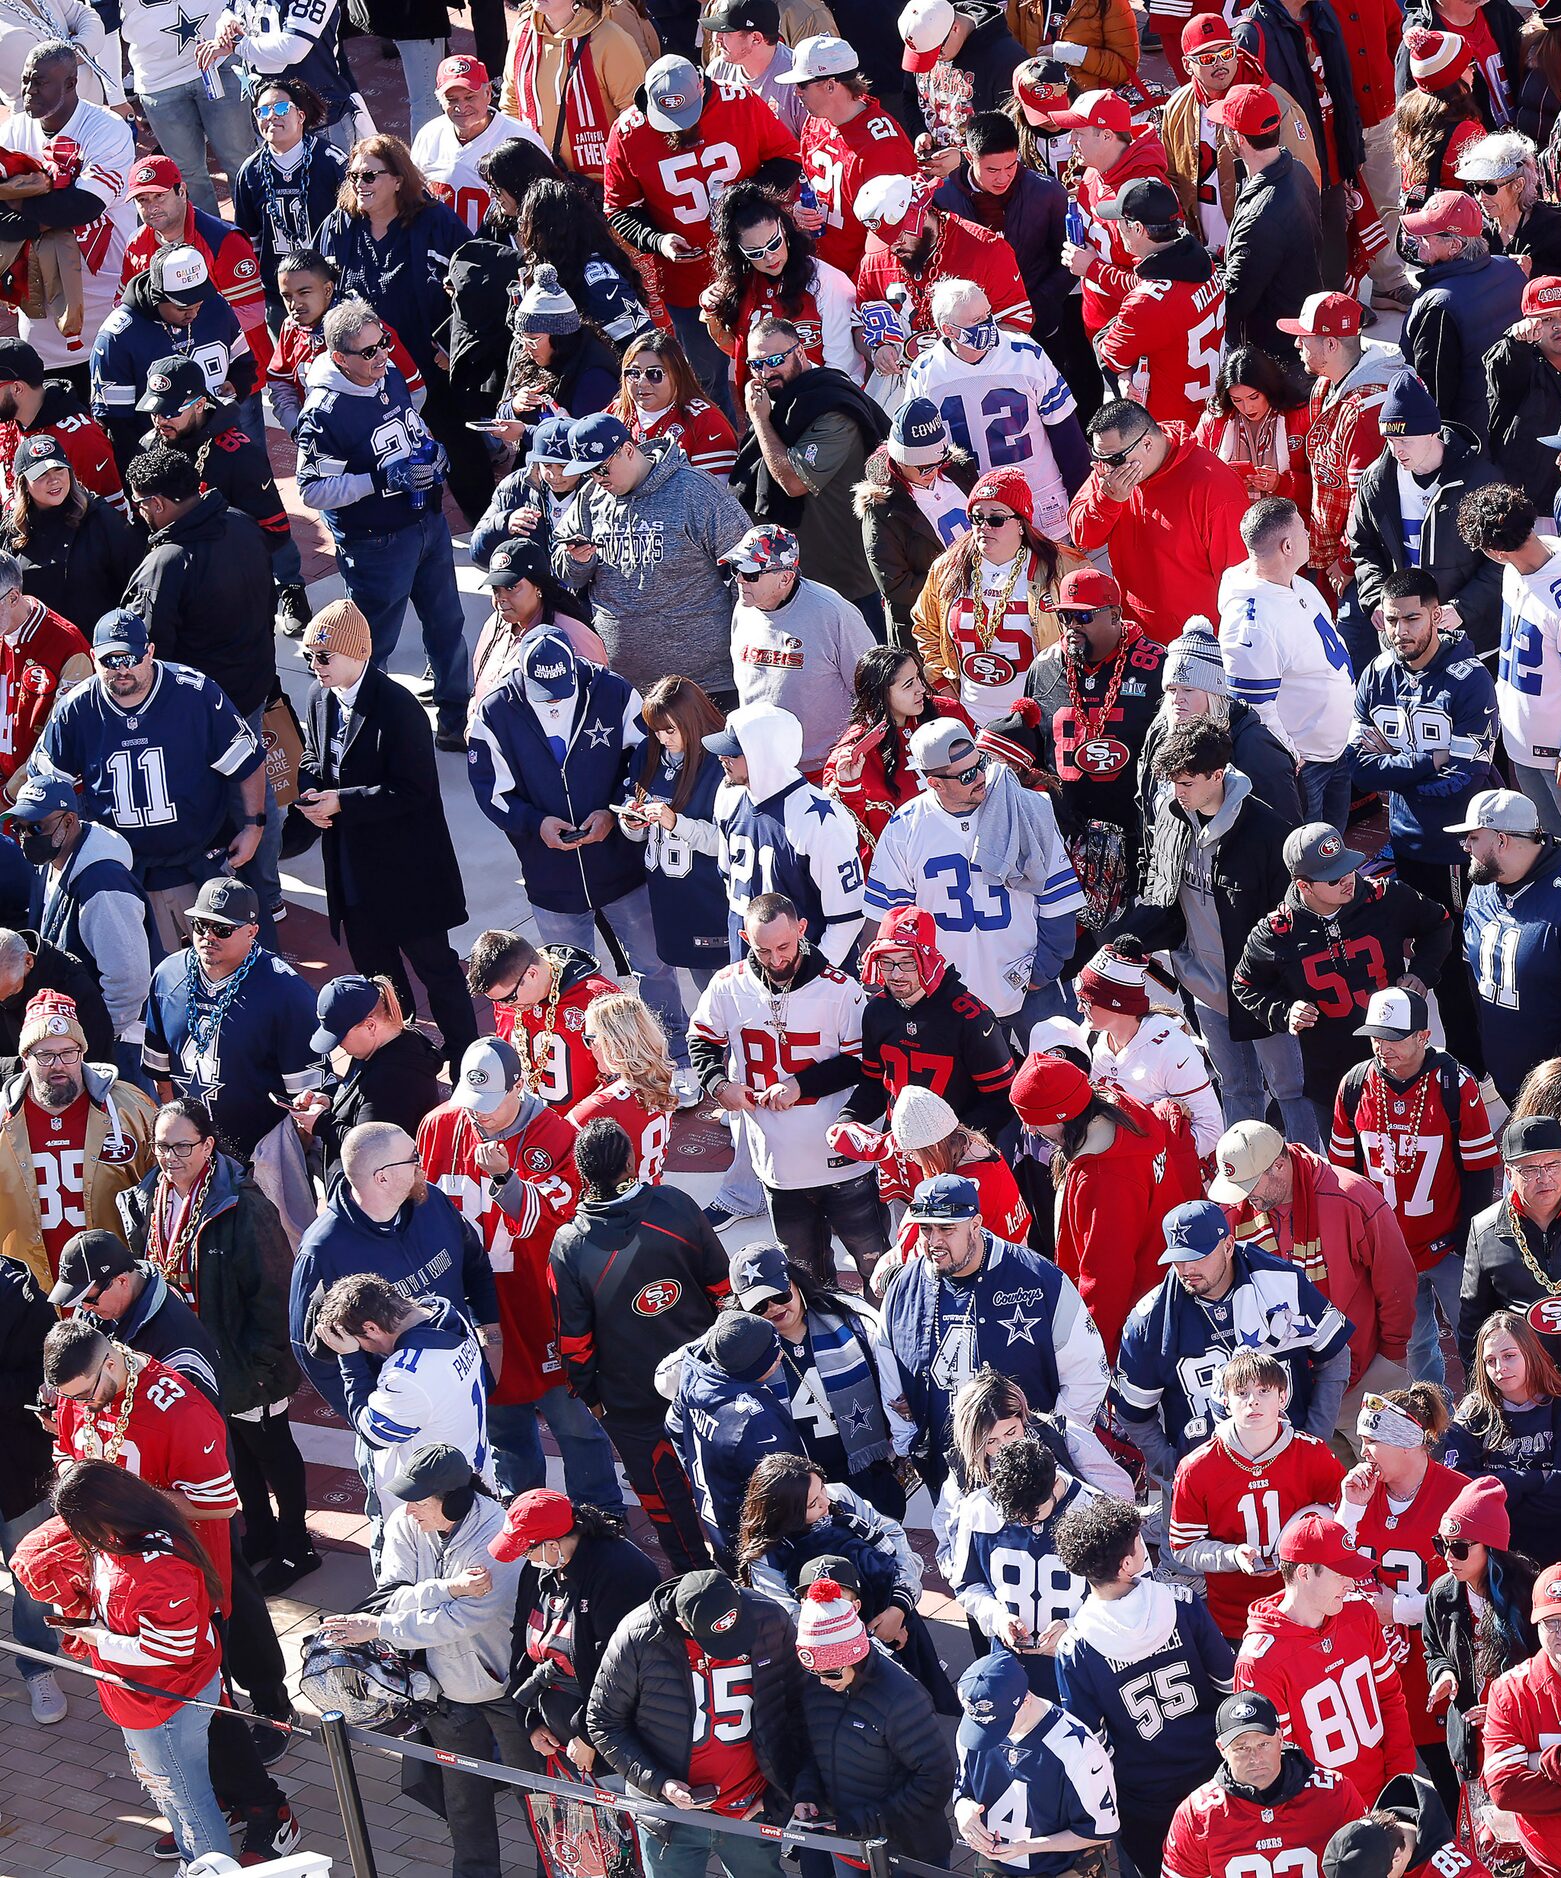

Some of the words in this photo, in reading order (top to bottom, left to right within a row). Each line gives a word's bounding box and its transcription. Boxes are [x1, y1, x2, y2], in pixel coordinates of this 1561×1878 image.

[867, 116, 899, 140] 21
[659, 142, 741, 224] 52
[175, 267, 202, 278] GALLERY
[181, 274, 200, 284] DEPT
[1192, 271, 1225, 312] WILLIS
[215, 426, 250, 452] 85
[938, 387, 1033, 470] 12
[535, 660, 564, 674] DALLAS
[1130, 637, 1166, 670] 85
[1312, 613, 1355, 686] 4
[534, 666, 567, 680] COWBOYS
[105, 747, 178, 829] 11
[839, 859, 863, 894] 21
[923, 853, 1013, 933] 33
[1301, 935, 1390, 1018] 53
[1477, 921, 1521, 1011] 11
[741, 1028, 821, 1105] 85
[1360, 1131, 1443, 1216] 97
[992, 1287, 1044, 1307] Cowboys
[392, 1348, 423, 1374] 11
[929, 1323, 977, 1417] 4
[146, 1377, 186, 1412] 23
[734, 1392, 763, 1416] 4
[792, 1366, 840, 1439] 4
[1248, 1479, 1270, 1489] 49ERS
[1238, 1491, 1284, 1552] 11
[1118, 1661, 1198, 1741] 55
[1300, 1655, 1385, 1768] 80
[457, 1758, 479, 1769] STADIUM
[1100, 1786, 1116, 1818] 4
[782, 1831, 806, 1842] STADIUM
[986, 1779, 1034, 1870] 4
[1255, 1837, 1283, 1850] 49ERS
[1431, 1840, 1472, 1878] 85
